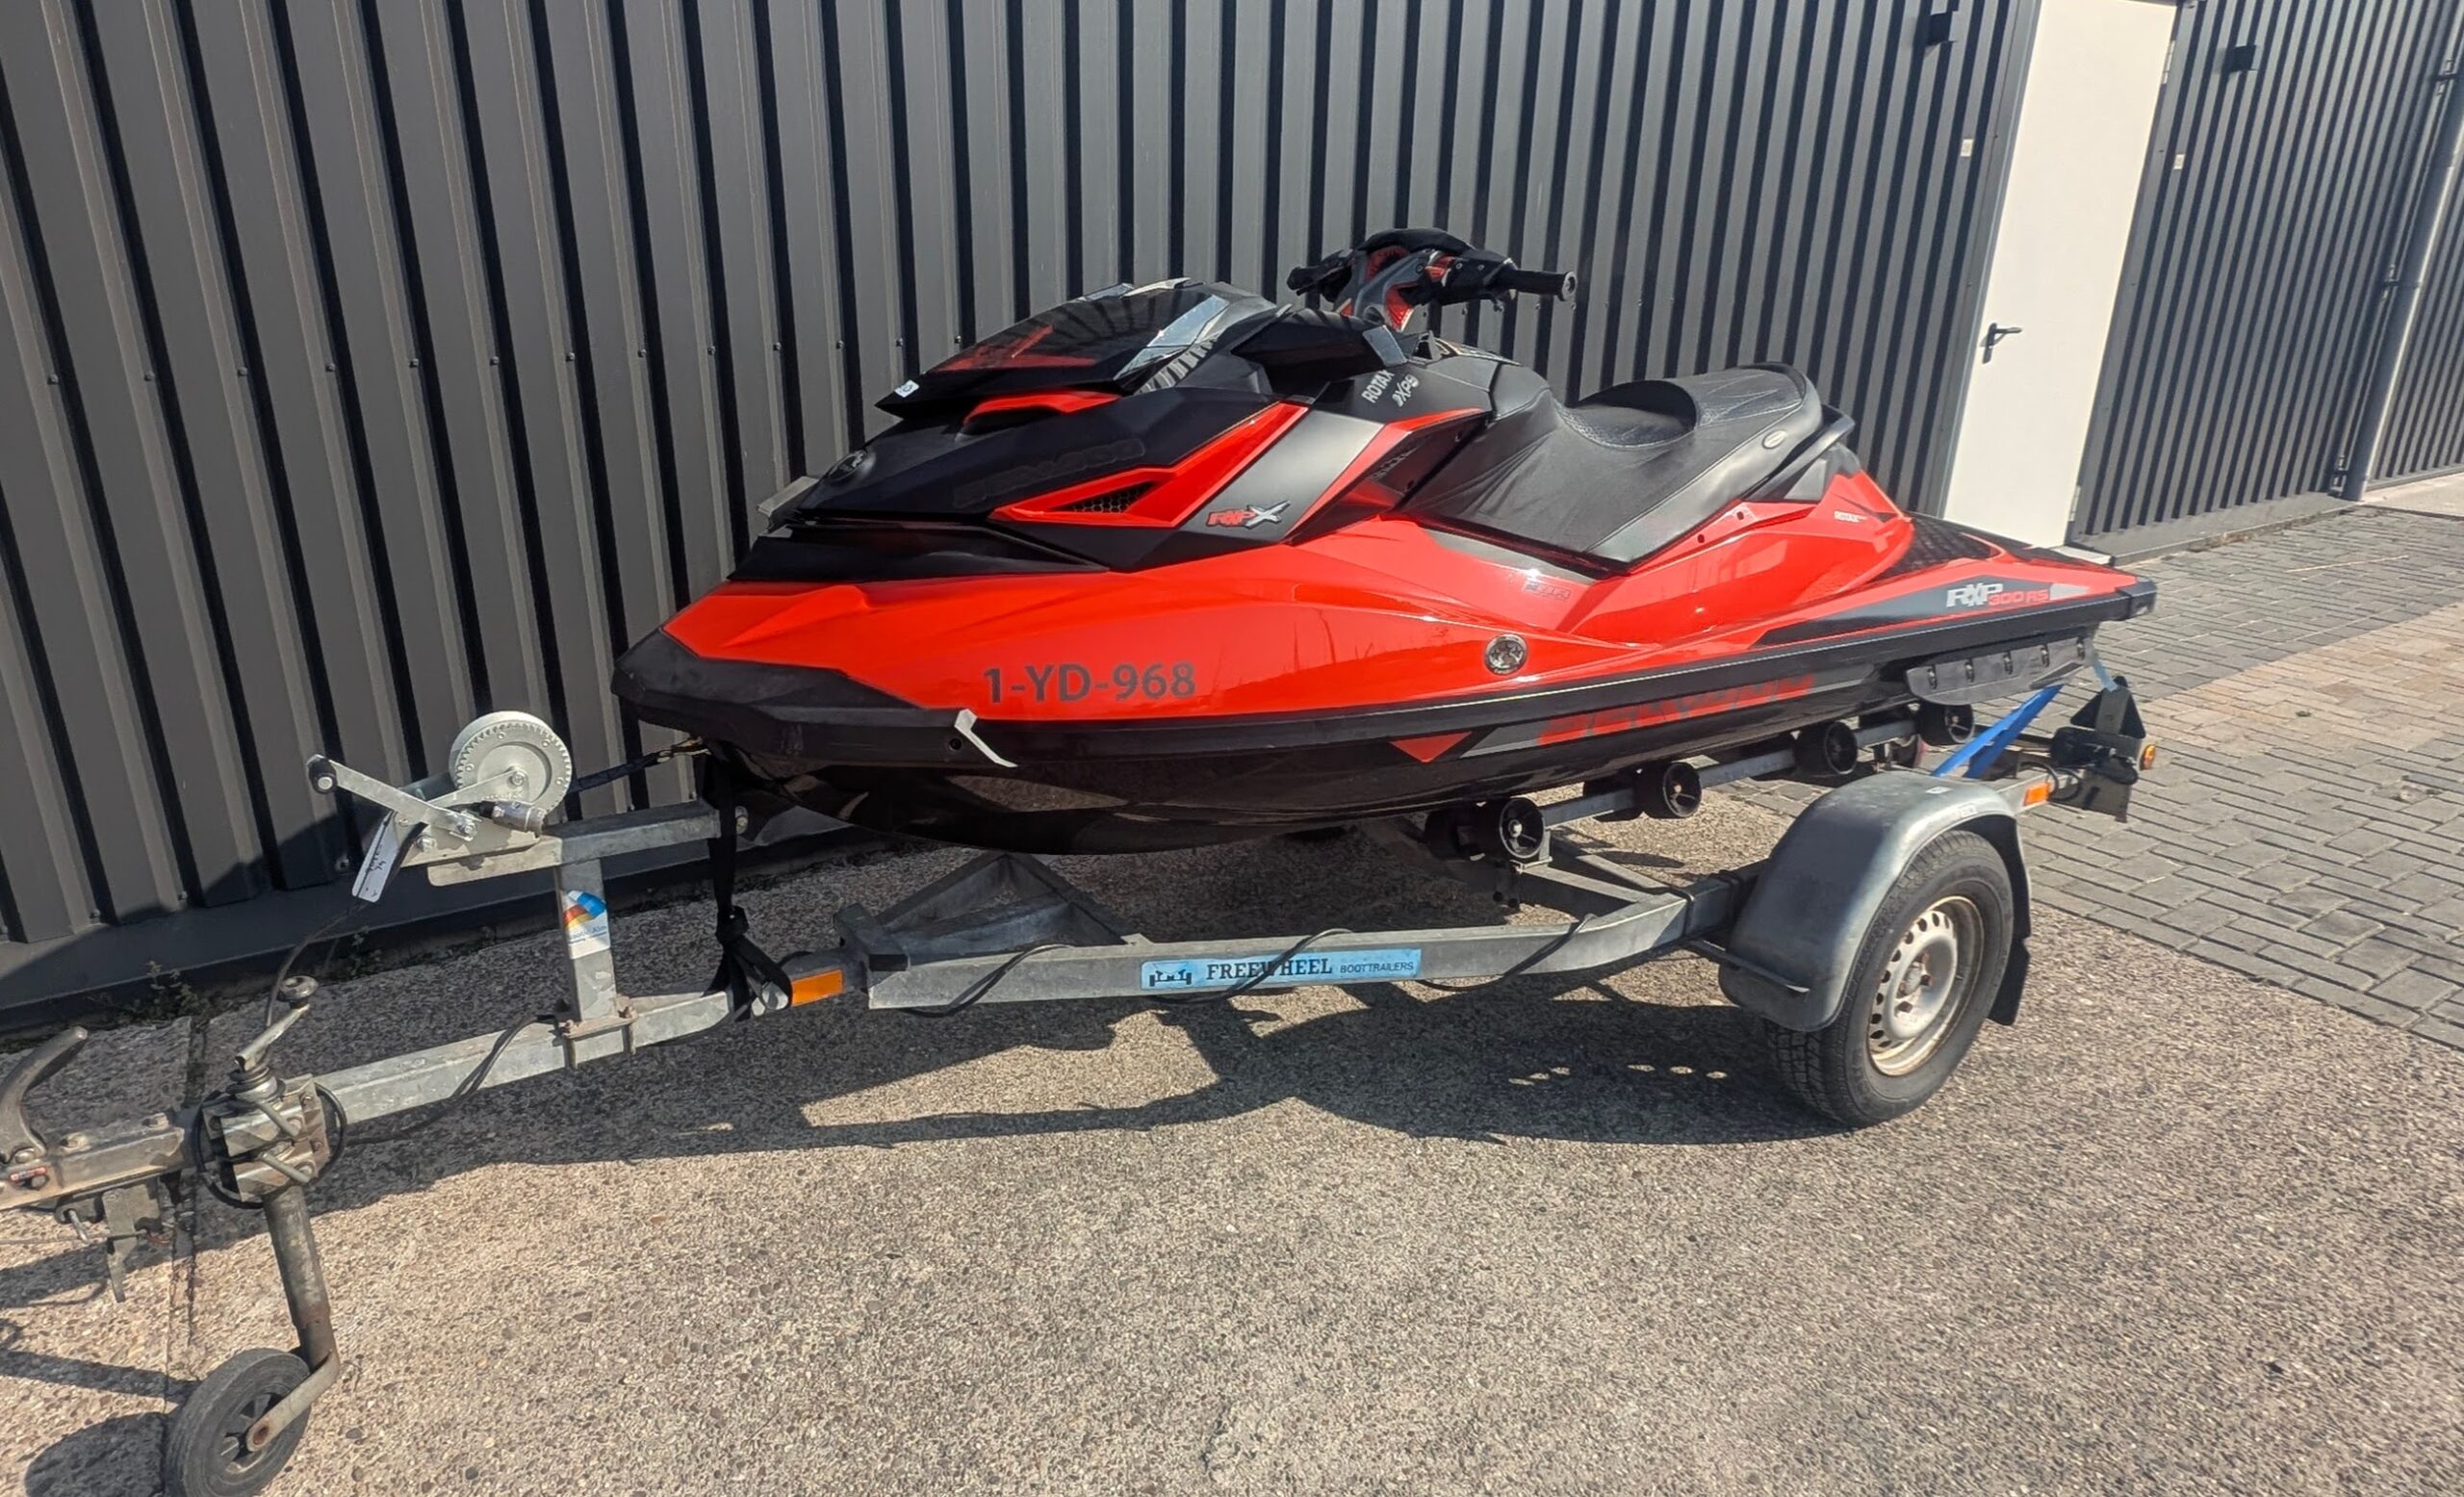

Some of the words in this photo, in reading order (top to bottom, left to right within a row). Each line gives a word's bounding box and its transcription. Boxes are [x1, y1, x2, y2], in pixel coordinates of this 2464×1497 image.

[1361, 369, 1395, 404] ROTAX
[1988, 591, 2024, 606] 300
[984, 662, 1196, 704] 1-YD-968
[1340, 962, 1414, 973] BOOTTRAILERS
